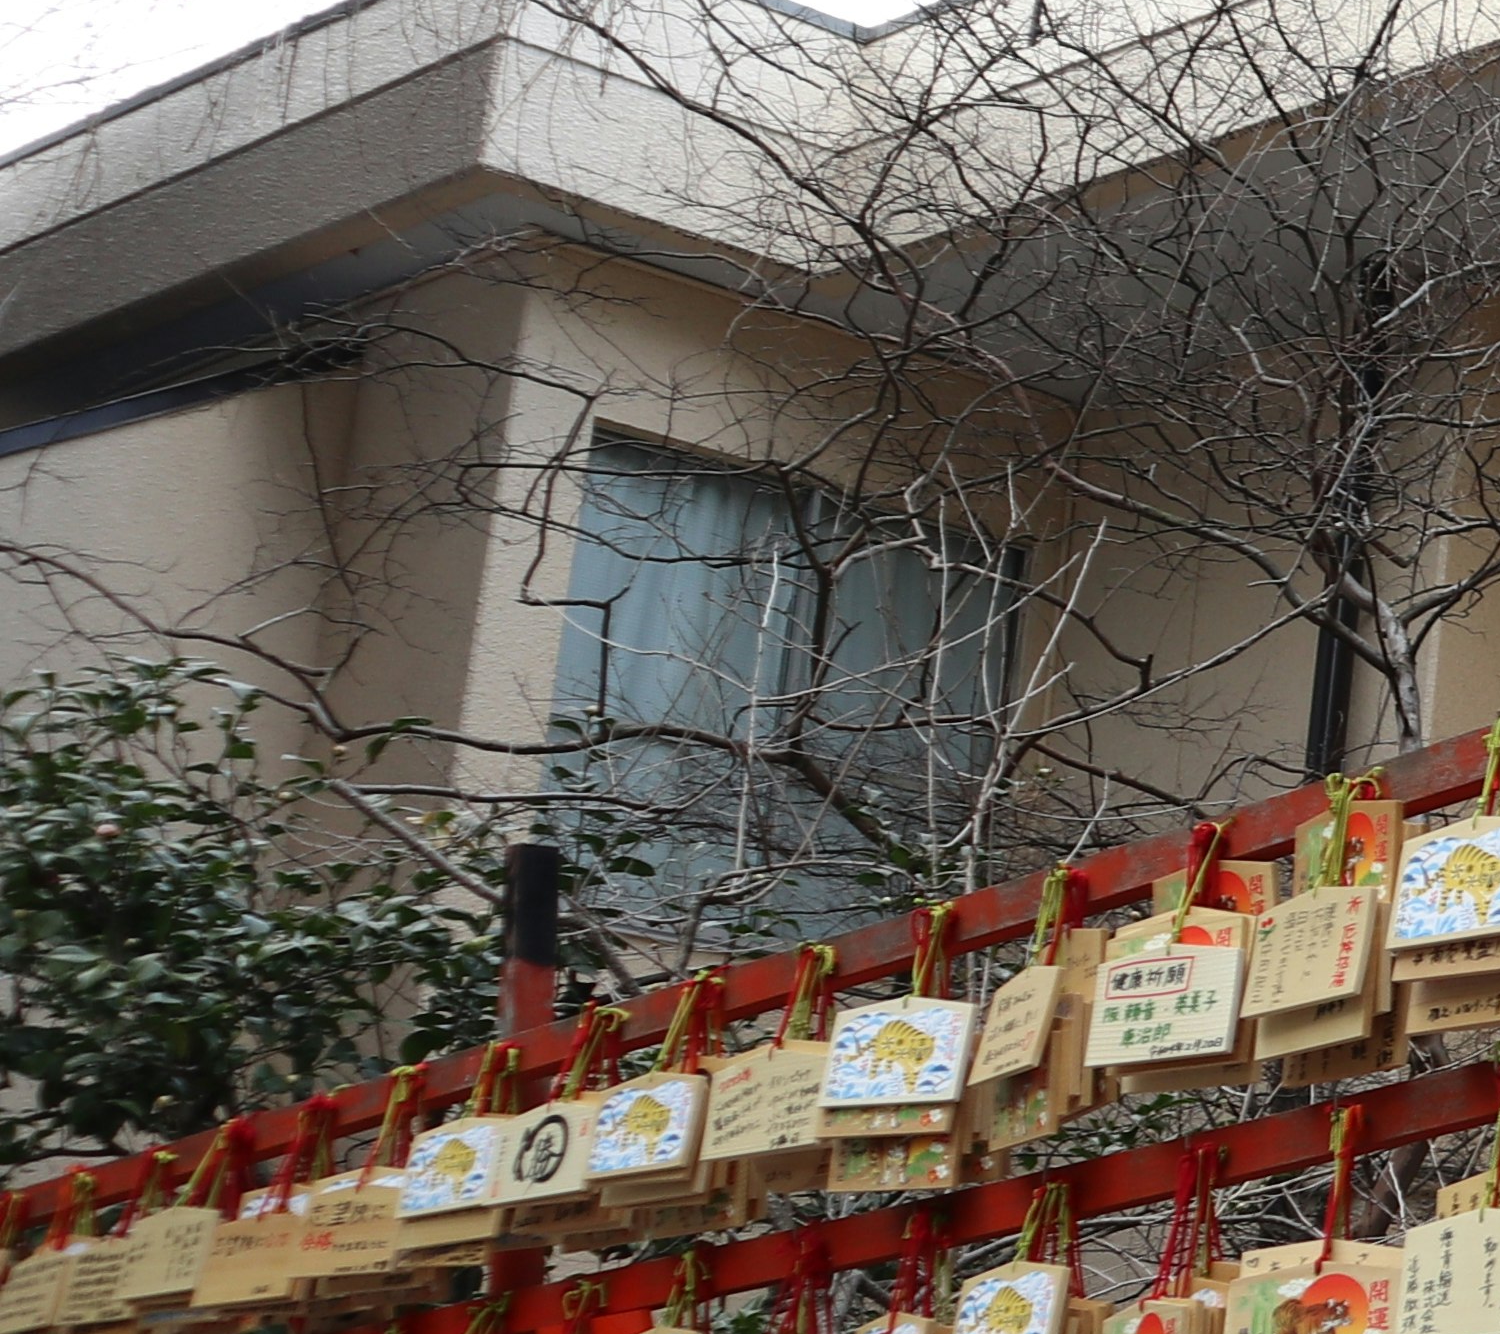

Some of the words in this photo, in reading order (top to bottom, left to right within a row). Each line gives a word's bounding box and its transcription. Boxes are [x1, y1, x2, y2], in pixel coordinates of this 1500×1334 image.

[1110, 962, 1187, 992] 健康祈願
[1367, 1279, 1390, 1331] 開運
